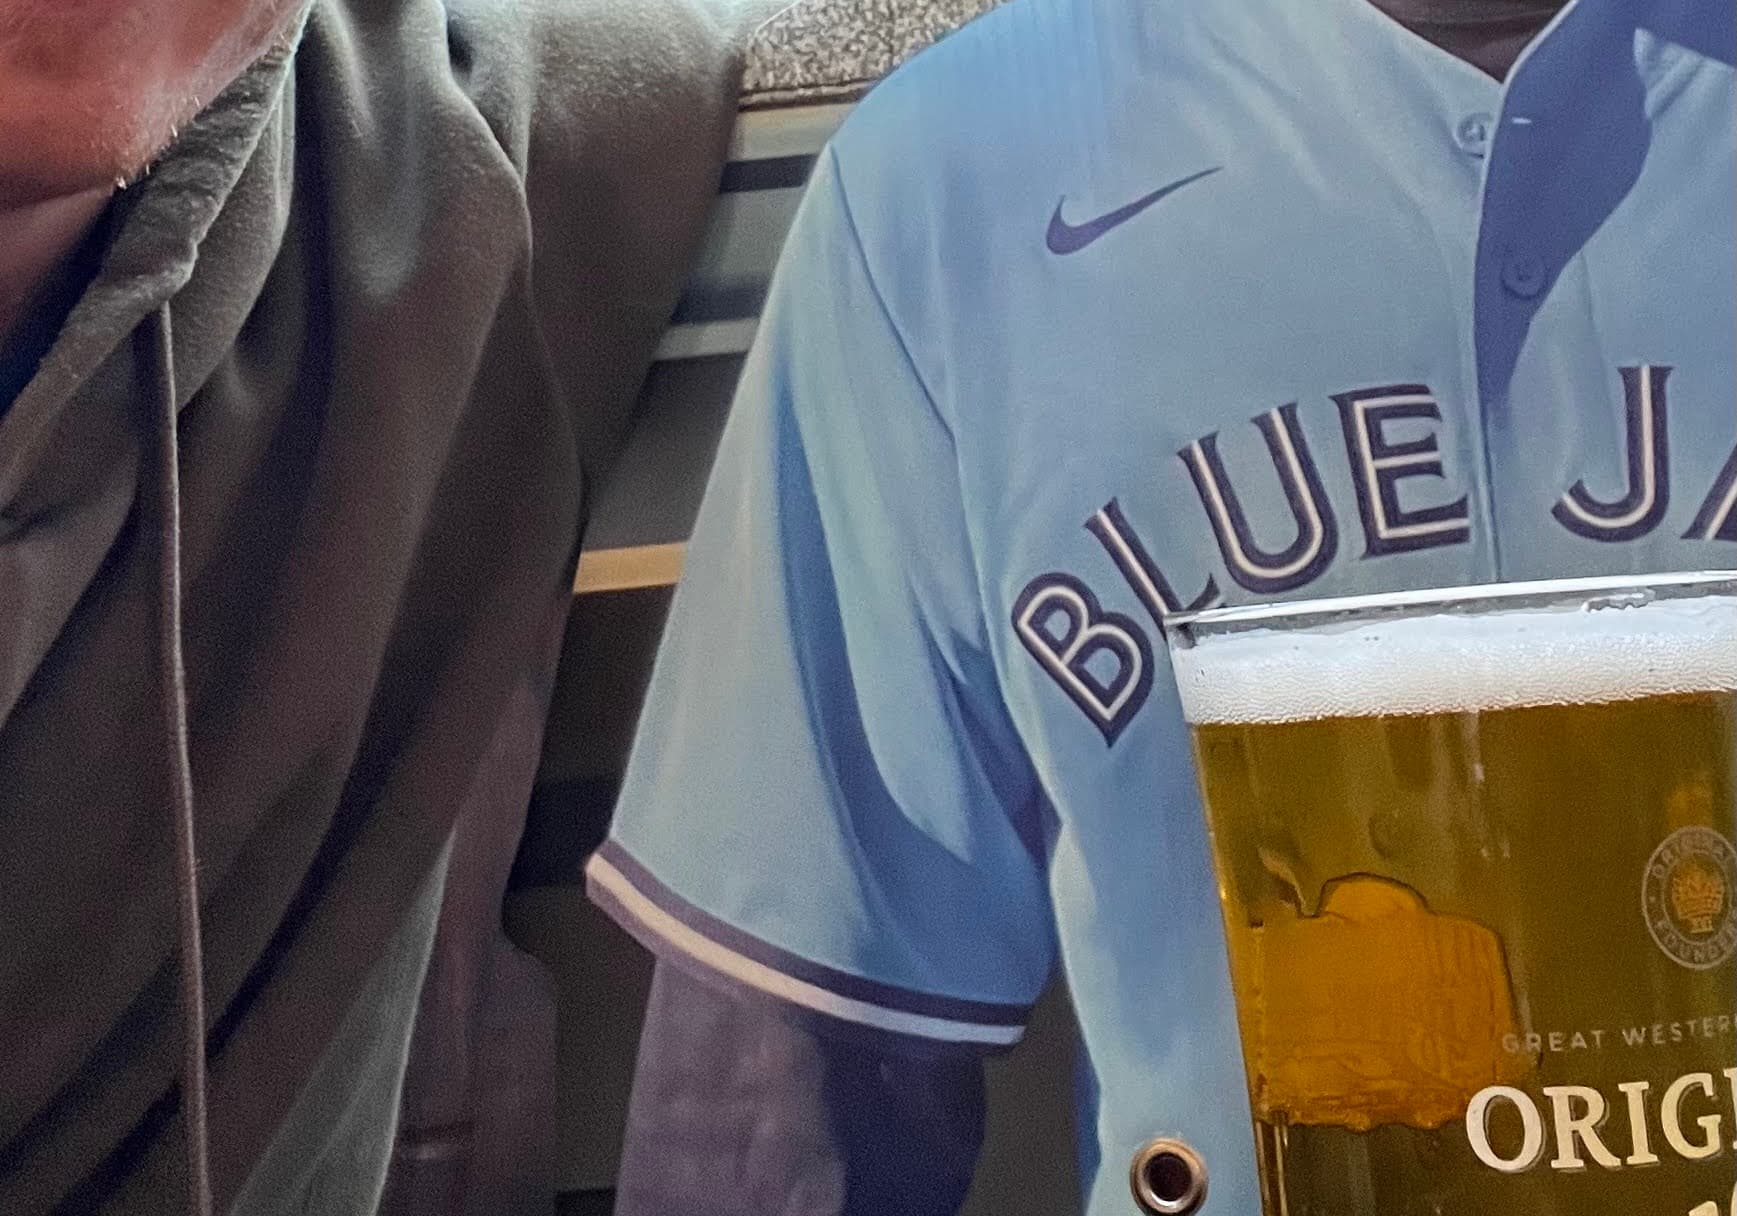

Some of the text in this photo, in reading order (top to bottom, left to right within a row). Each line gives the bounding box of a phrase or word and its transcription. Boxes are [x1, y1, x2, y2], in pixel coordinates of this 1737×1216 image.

[1011, 383, 1471, 749] BLUE
[1502, 1014, 1737, 1054] GREAT WESTER
